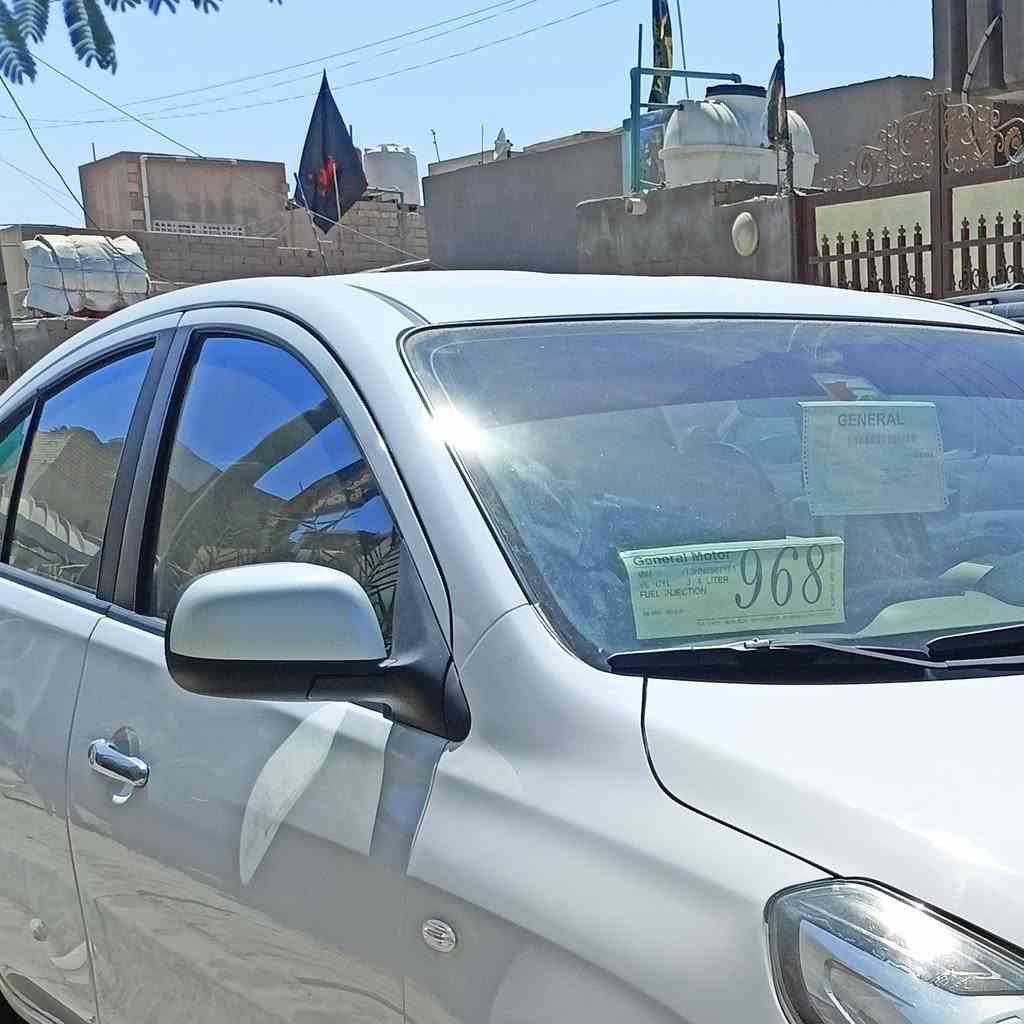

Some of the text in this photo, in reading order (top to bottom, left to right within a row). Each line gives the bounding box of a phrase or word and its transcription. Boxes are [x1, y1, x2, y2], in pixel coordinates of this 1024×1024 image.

[837, 412, 905, 427] GENERAL
[633, 550, 731, 567] General Motor
[734, 543, 825, 609] 968
[639, 590, 660, 599] FUEL
